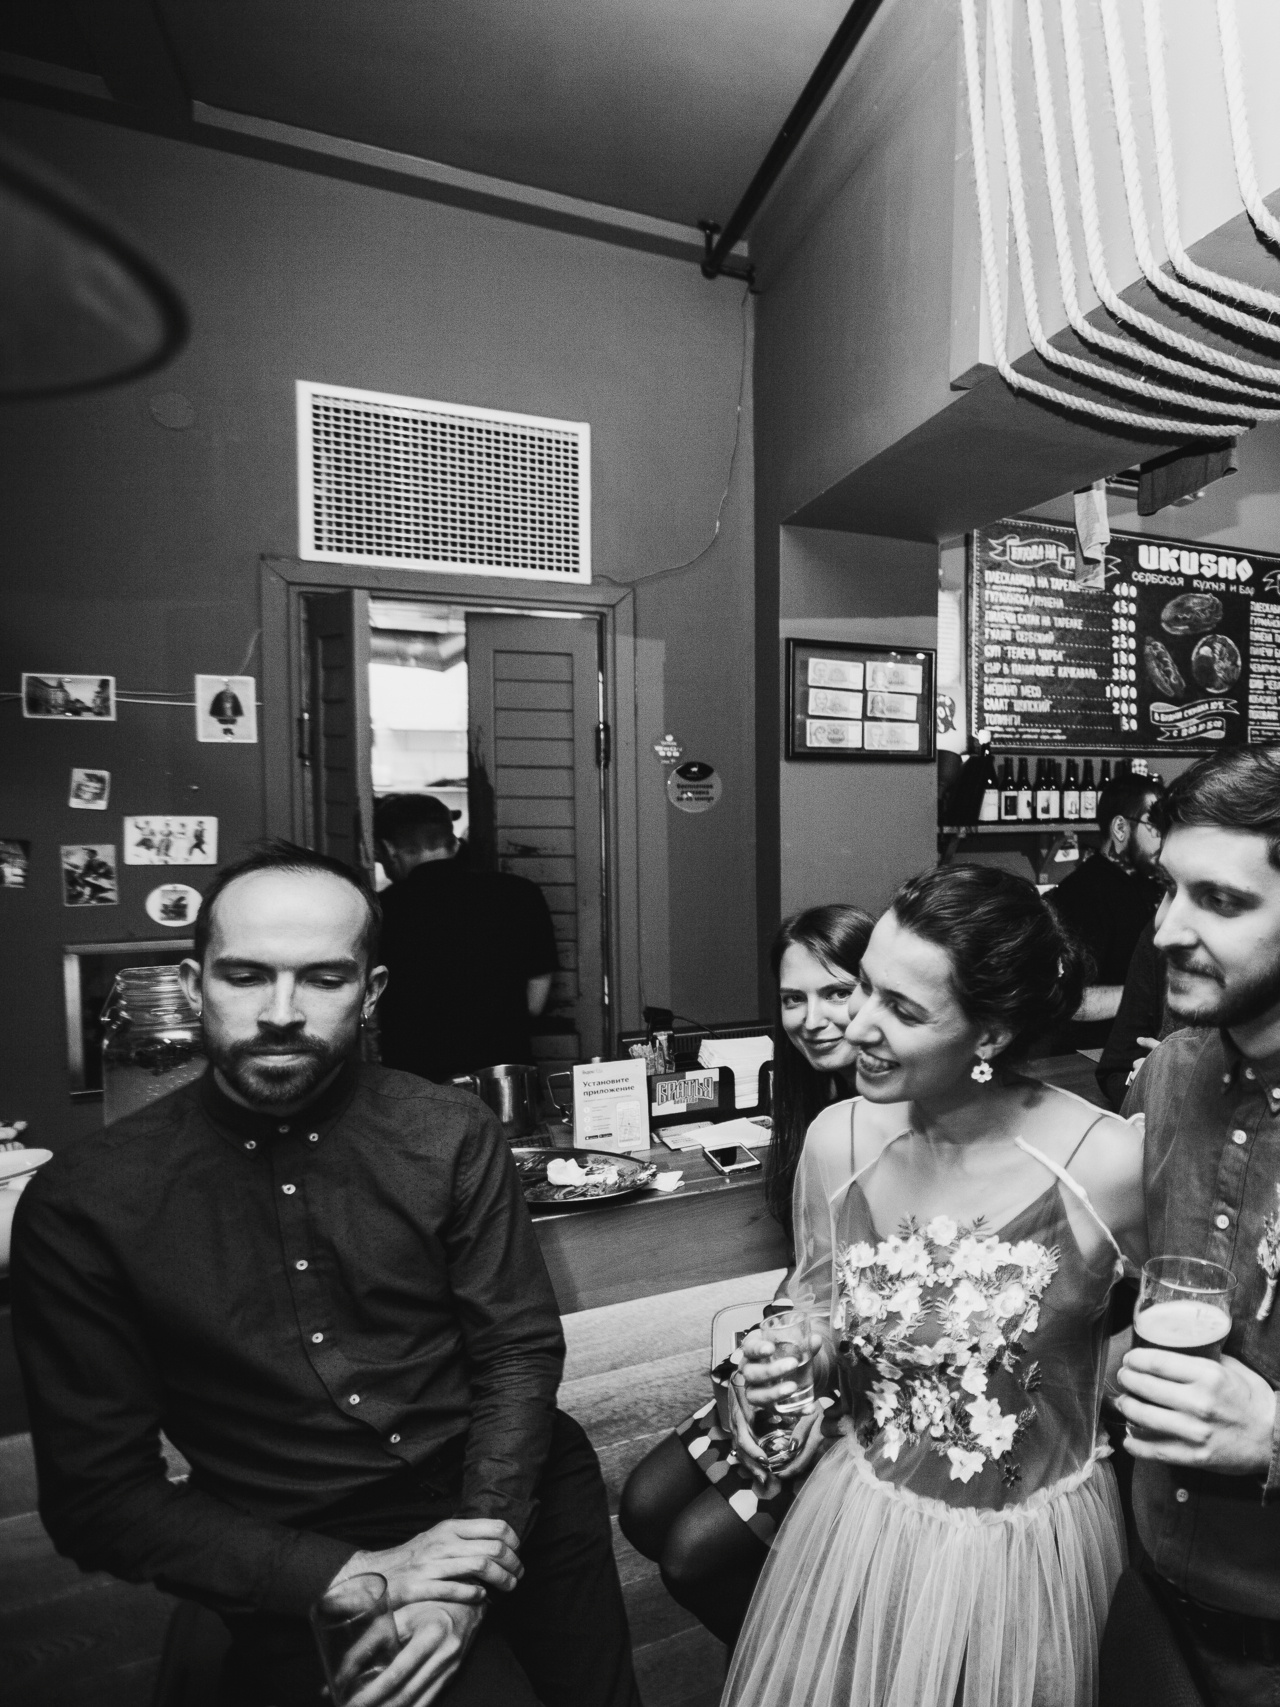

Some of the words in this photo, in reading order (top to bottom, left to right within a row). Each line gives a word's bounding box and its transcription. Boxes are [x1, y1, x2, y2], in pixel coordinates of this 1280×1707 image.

[1138, 544, 1253, 582] UKUSNO
[1112, 582, 1138, 598] 400
[1112, 599, 1137, 616] 450
[1111, 617, 1136, 633] 380
[1111, 633, 1136, 650] 250
[1112, 651, 1136, 666] 180
[1112, 666, 1136, 682] 380
[1105, 684, 1138, 699] 1000
[1112, 701, 1138, 715] 200
[1121, 716, 1138, 731] 50
[583, 1077, 630, 1087] Установите
[583, 1085, 635, 1097] приложение
